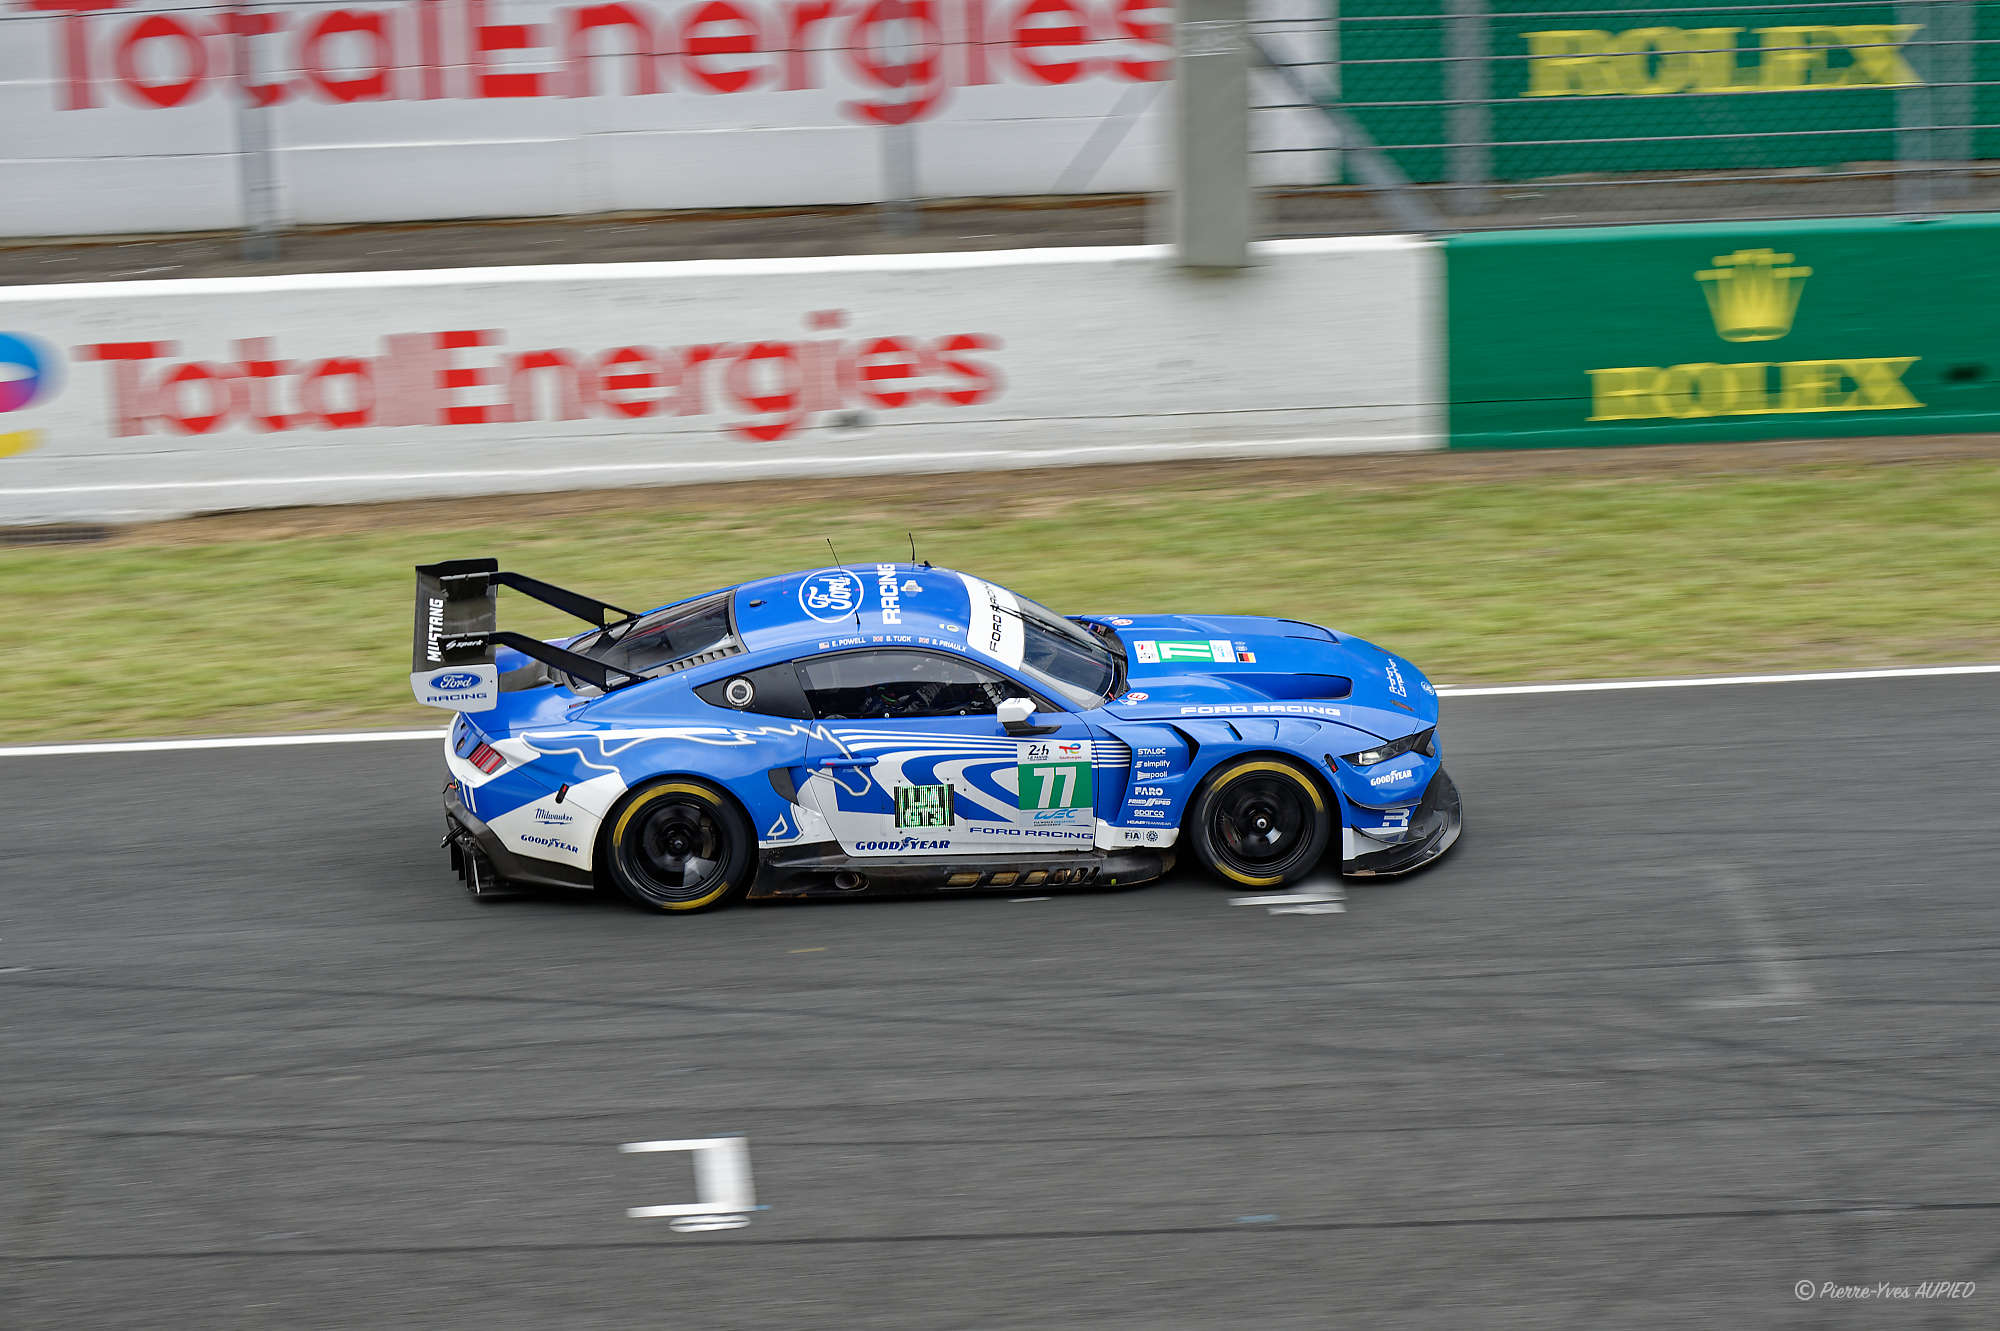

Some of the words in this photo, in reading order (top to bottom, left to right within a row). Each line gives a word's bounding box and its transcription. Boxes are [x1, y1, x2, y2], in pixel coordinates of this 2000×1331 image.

[22, 0, 1178, 125] TotalEnergies
[1519, 24, 1922, 97] ROLEX
[74, 308, 1005, 441] TotalEnergies
[1586, 356, 1924, 422] ROLEX
[808, 575, 853, 610] Ford
[876, 563, 902, 625] RACING
[427, 598, 444, 662] MUSTANG
[989, 614, 1002, 652] FORD
[838, 636, 866, 646] POWELL
[440, 674, 472, 689] Ford
[426, 692, 487, 702] RACING
[1180, 705, 1247, 715] FORD
[1252, 704, 1341, 716] RACING
[1144, 760, 1171, 768] simplify
[1151, 771, 1168, 779] paoli
[1370, 769, 1413, 786] GOODYEAR
[1033, 766, 1077, 809] 77
[1135, 787, 1164, 796] FARO
[535, 808, 573, 822] Milwaukee
[1134, 809, 1165, 817] sparco
[970, 827, 1020, 836] FORD
[1025, 830, 1094, 839] RACING
[520, 834, 579, 854] GOODYEAR
[855, 836, 951, 852] GOODYEAR
